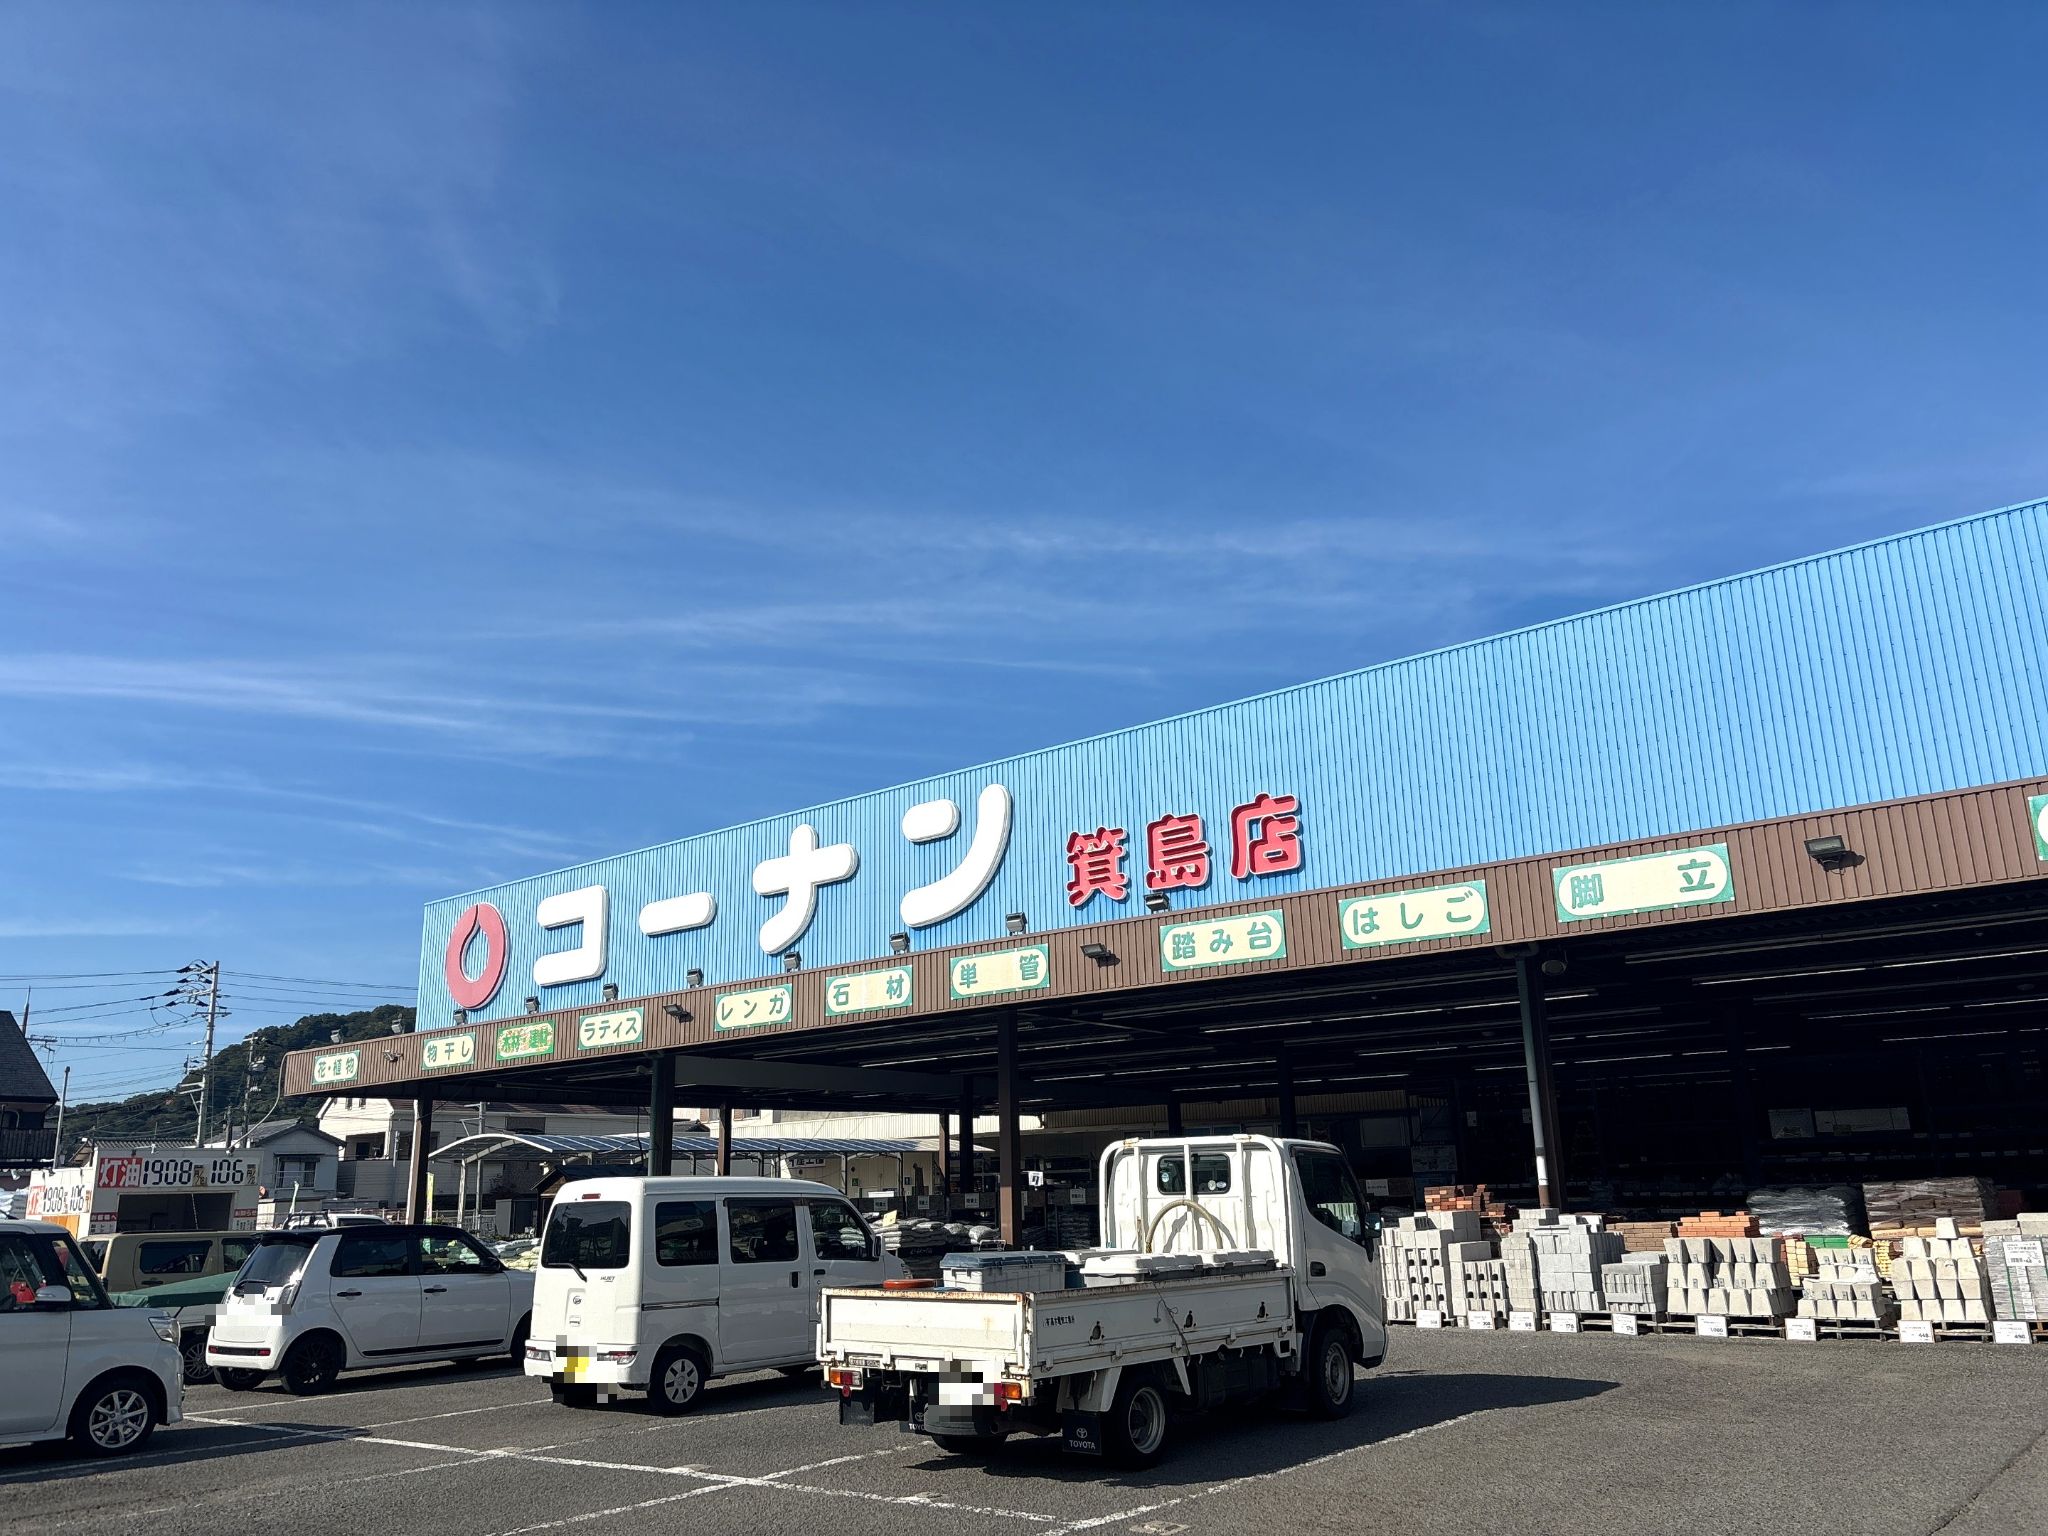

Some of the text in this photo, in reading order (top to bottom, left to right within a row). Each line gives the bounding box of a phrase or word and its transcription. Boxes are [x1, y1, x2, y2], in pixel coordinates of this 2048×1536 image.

[533, 783, 1300, 986] コーナン 箕島店
[1570, 858, 1715, 909] 脚立
[1353, 890, 1473, 935] はしご
[1172, 921, 1272, 960] 踏み台
[960, 954, 1040, 988] 単管
[721, 991, 786, 1020] レンガ
[832, 974, 904, 1007] 石材
[584, 1017, 638, 1041] ラティス
[427, 1041, 470, 1062] 物干し
[100, 1158, 140, 1187] 灯油
[143, 1159, 193, 1185] 1908
[211, 1159, 244, 1184] 106
[908, 1422, 925, 1431] TOYO
[1069, 1439, 1096, 1450] TOYOTA
